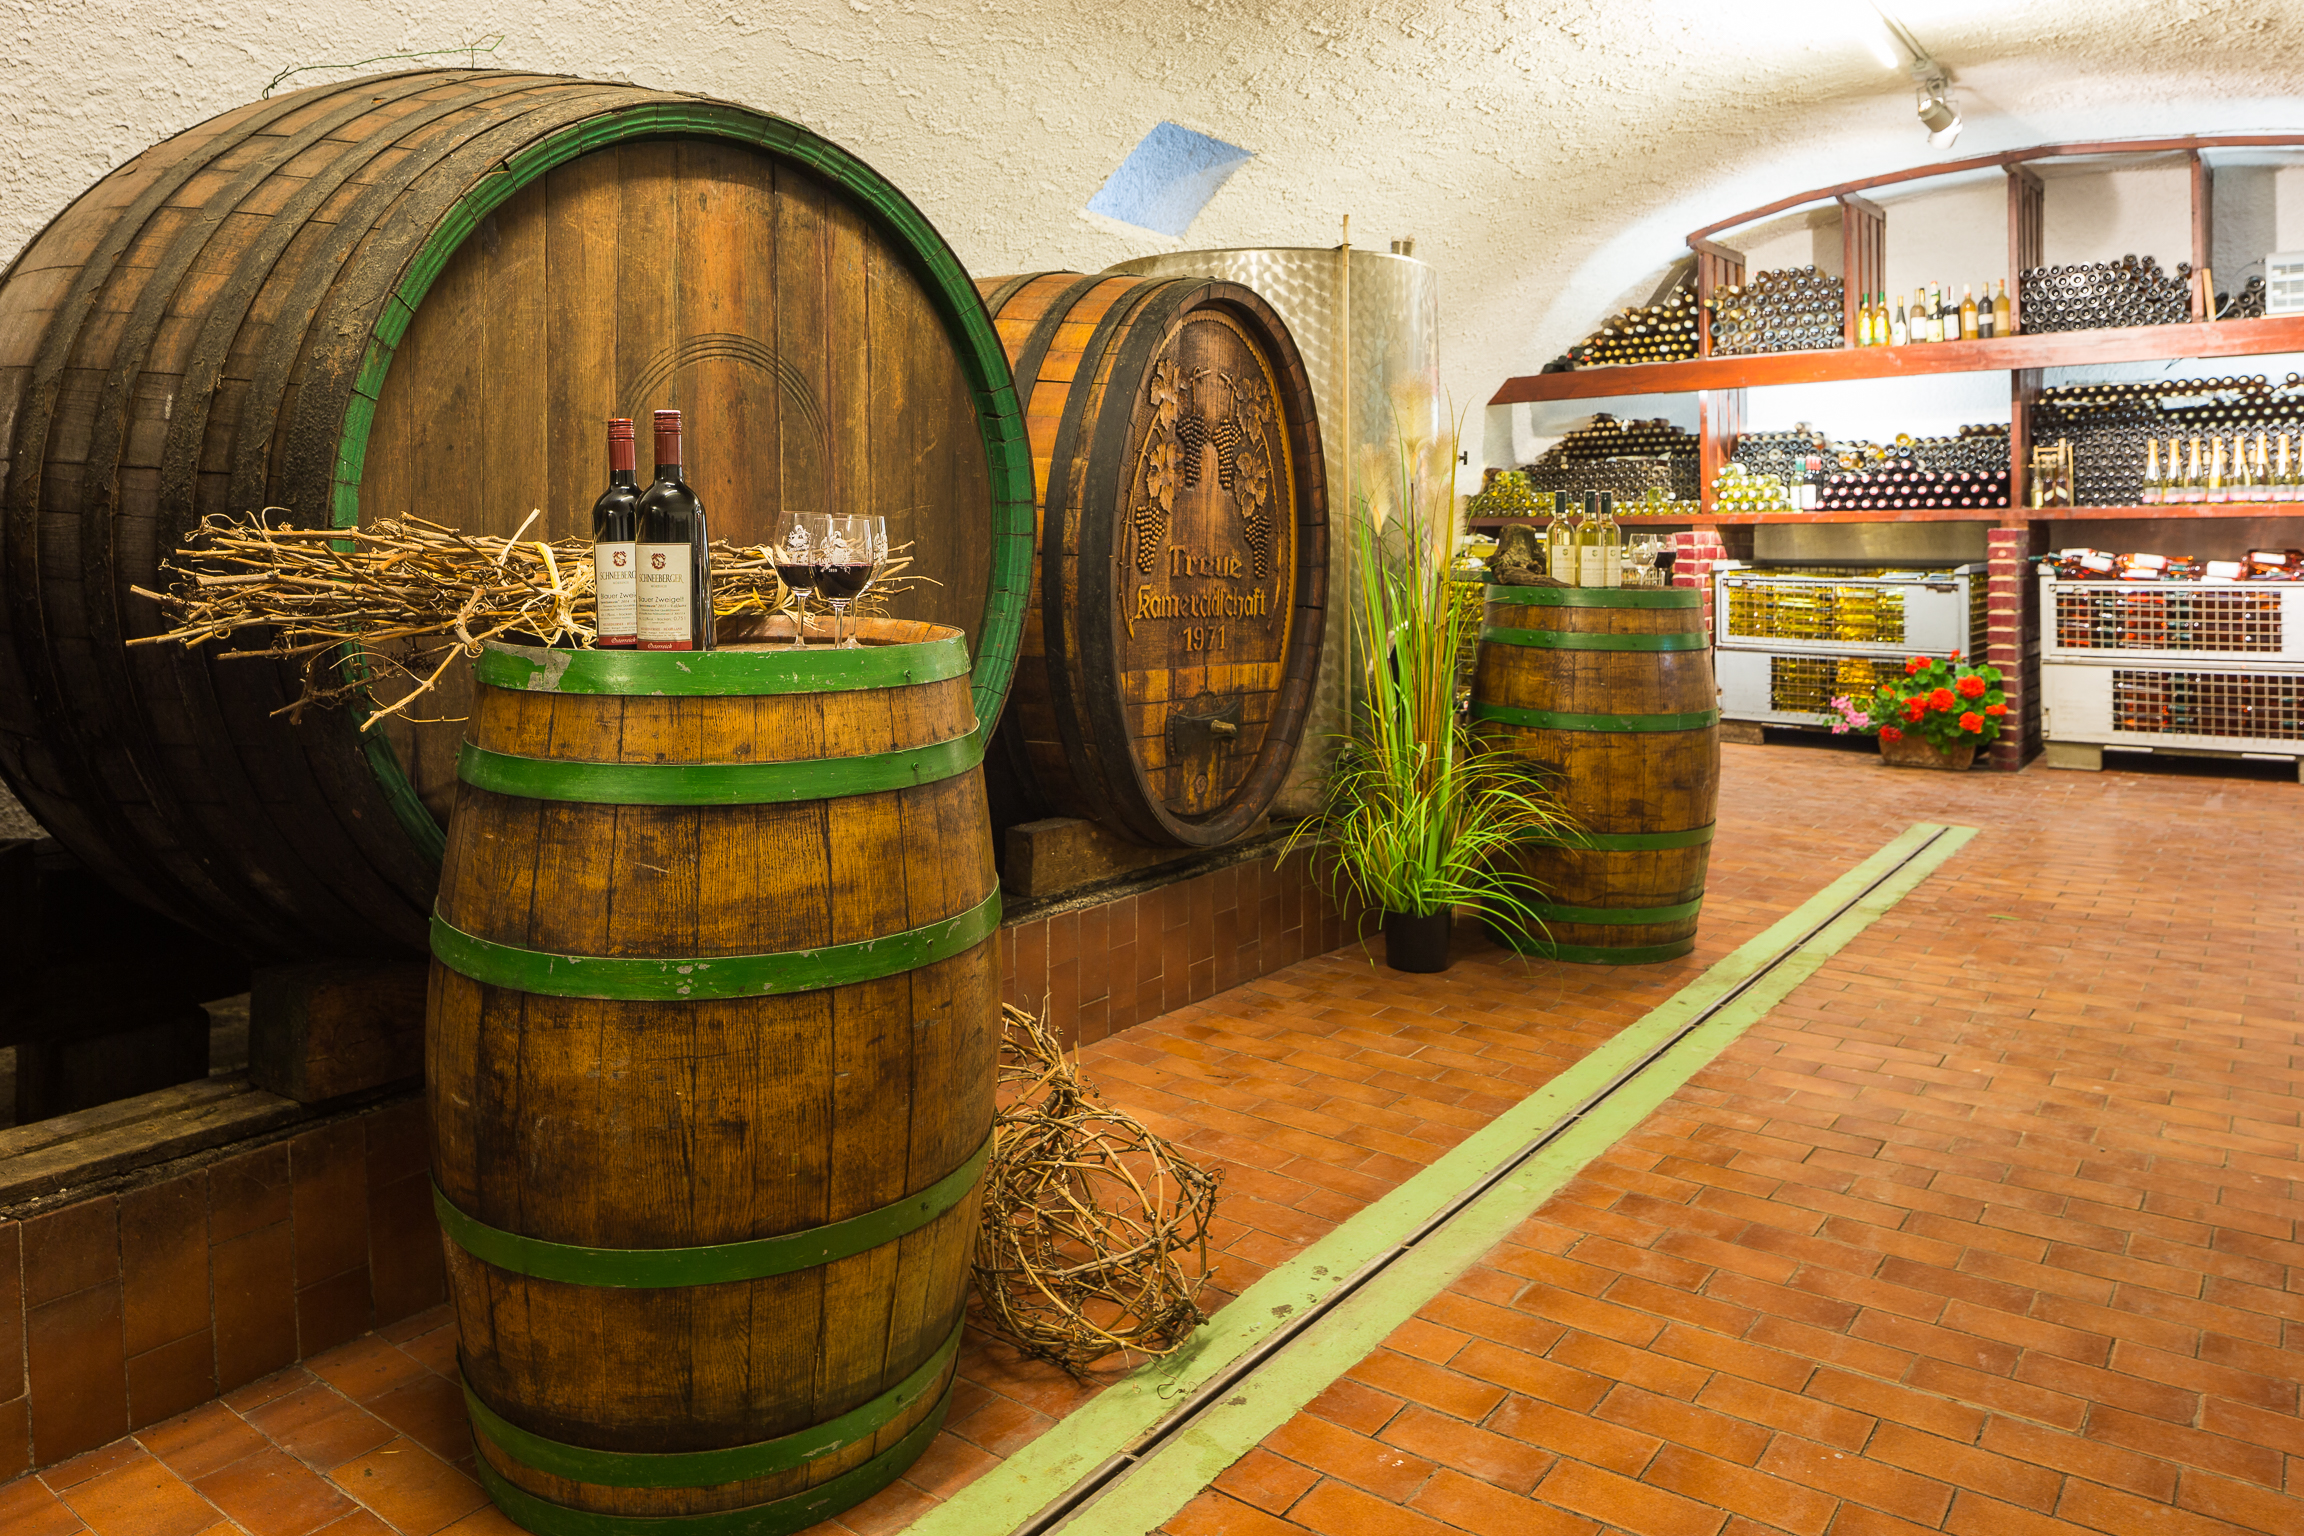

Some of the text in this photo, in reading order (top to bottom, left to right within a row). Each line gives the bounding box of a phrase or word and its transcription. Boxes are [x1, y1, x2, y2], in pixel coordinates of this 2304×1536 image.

[1168, 544, 1243, 579] Treue
[599, 570, 637, 581] SCHNEEBERG
[638, 573, 685, 584] SCHNEEBERGER
[1182, 624, 1226, 652] 1971
